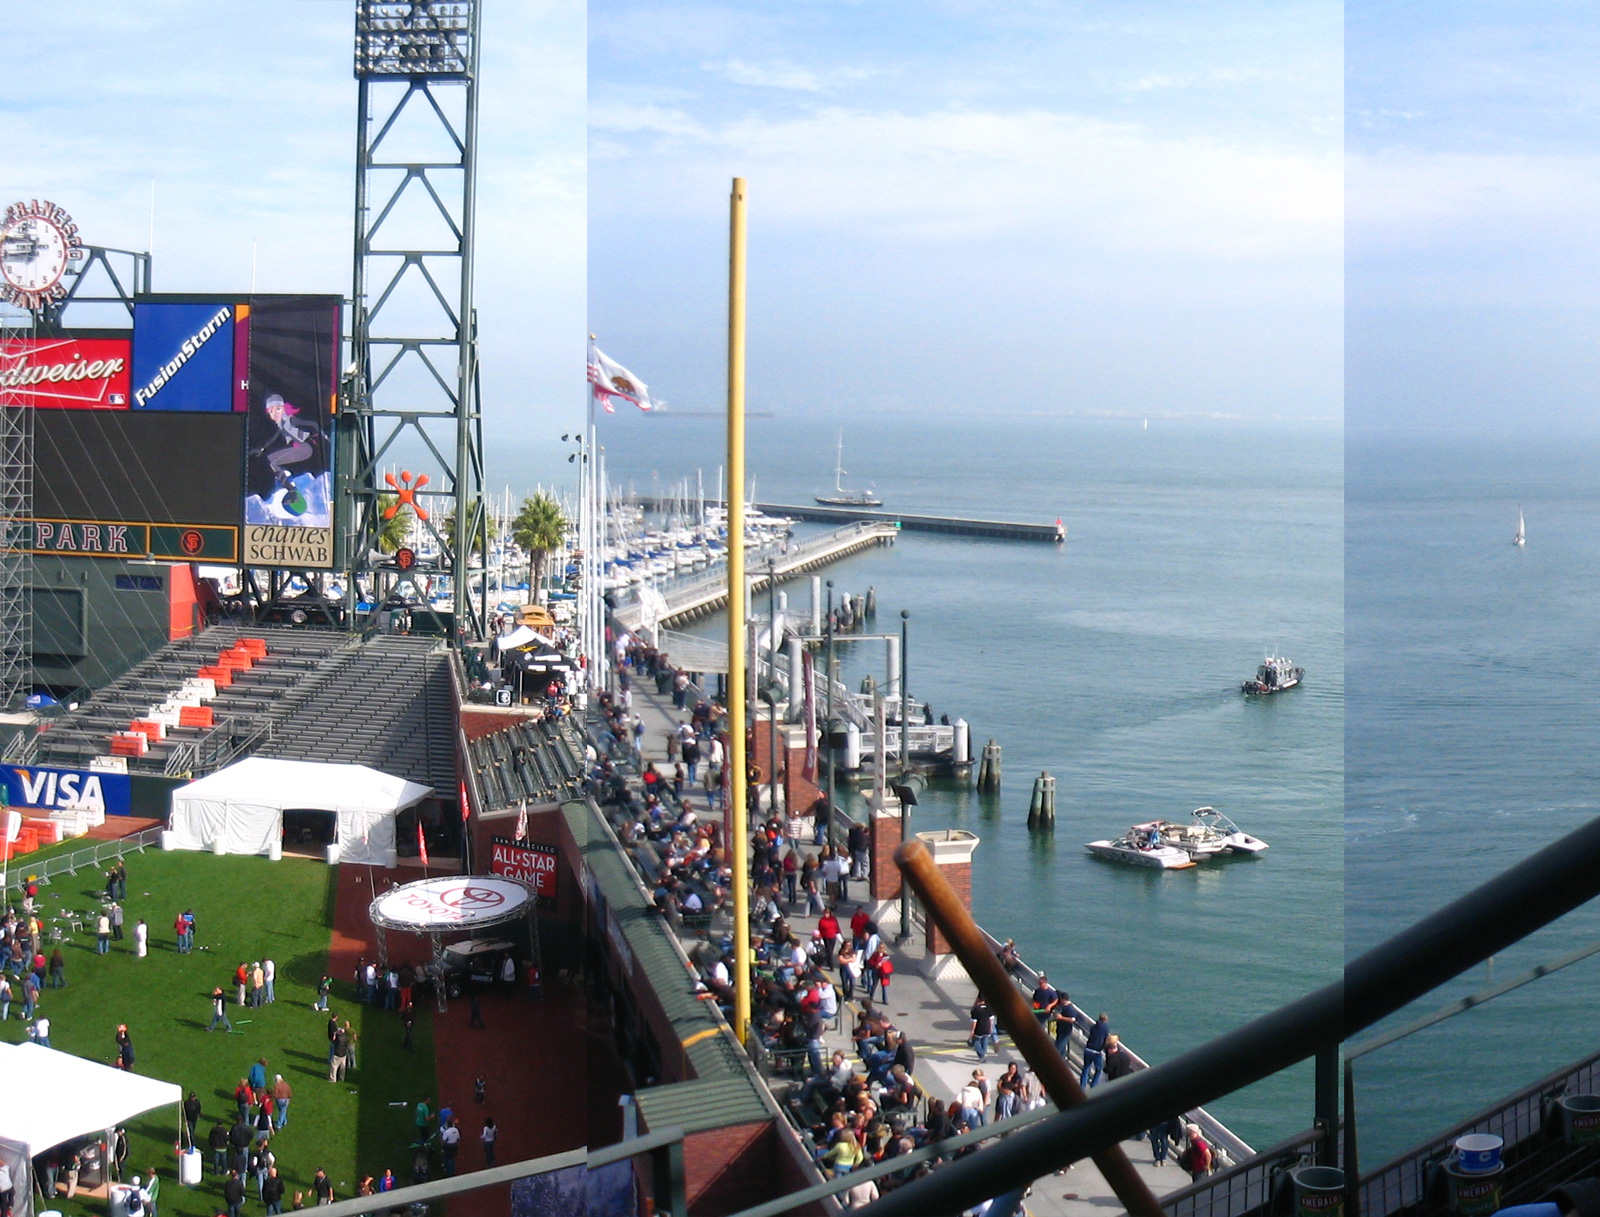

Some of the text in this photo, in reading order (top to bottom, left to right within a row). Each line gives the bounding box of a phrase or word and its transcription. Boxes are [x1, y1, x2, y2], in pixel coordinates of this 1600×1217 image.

[135, 306, 232, 407] FusionStorm
[36, 523, 128, 552] PARK
[250, 526, 325, 545] charles
[250, 545, 328, 562] SCHWAB
[15, 769, 104, 810] VISA
[503, 866, 545, 888] GAME
[400, 893, 466, 920] TOYOTA
